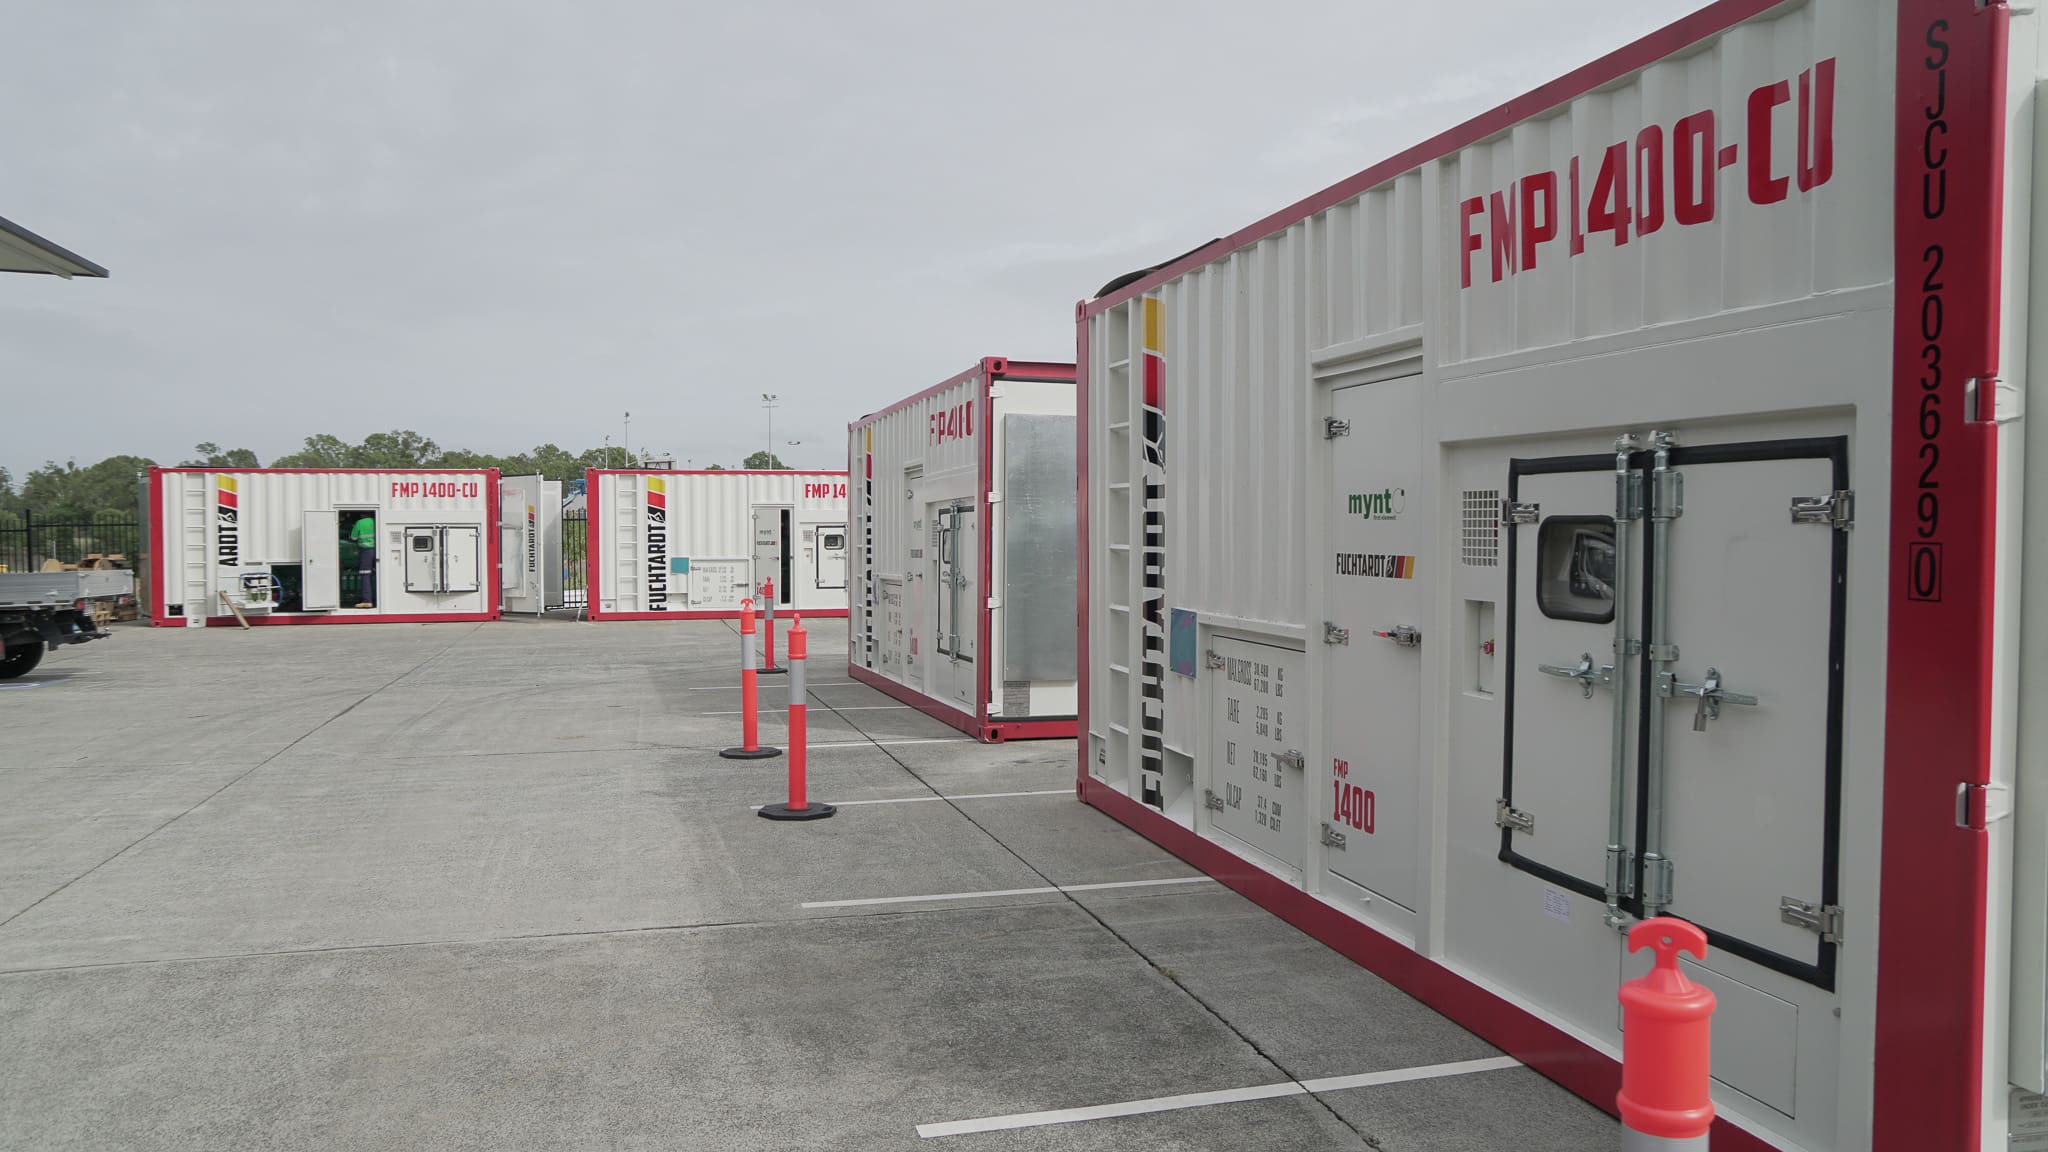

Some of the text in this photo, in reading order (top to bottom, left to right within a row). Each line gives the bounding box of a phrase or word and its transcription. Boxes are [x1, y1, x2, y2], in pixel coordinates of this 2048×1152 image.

[1922, 19, 1950, 219] SJCU
[1460, 57, 1836, 289] FMP 1400-CU
[1917, 244, 1944, 538] 203629
[392, 483, 478, 497] FMP 1400-CU
[805, 484, 830, 498] FMP
[1348, 489, 1392, 519] mynt
[648, 523, 667, 611] FUCHTARDT
[1336, 553, 1386, 577] FUCHTARDT
[1275, 683, 1283, 697] LBS
[1227, 697, 1240, 724] TARE
[1277, 712, 1282, 725] KG
[1226, 741, 1236, 765] NET
[1333, 758, 1348, 779] FMP
[1333, 780, 1375, 835] 1400
